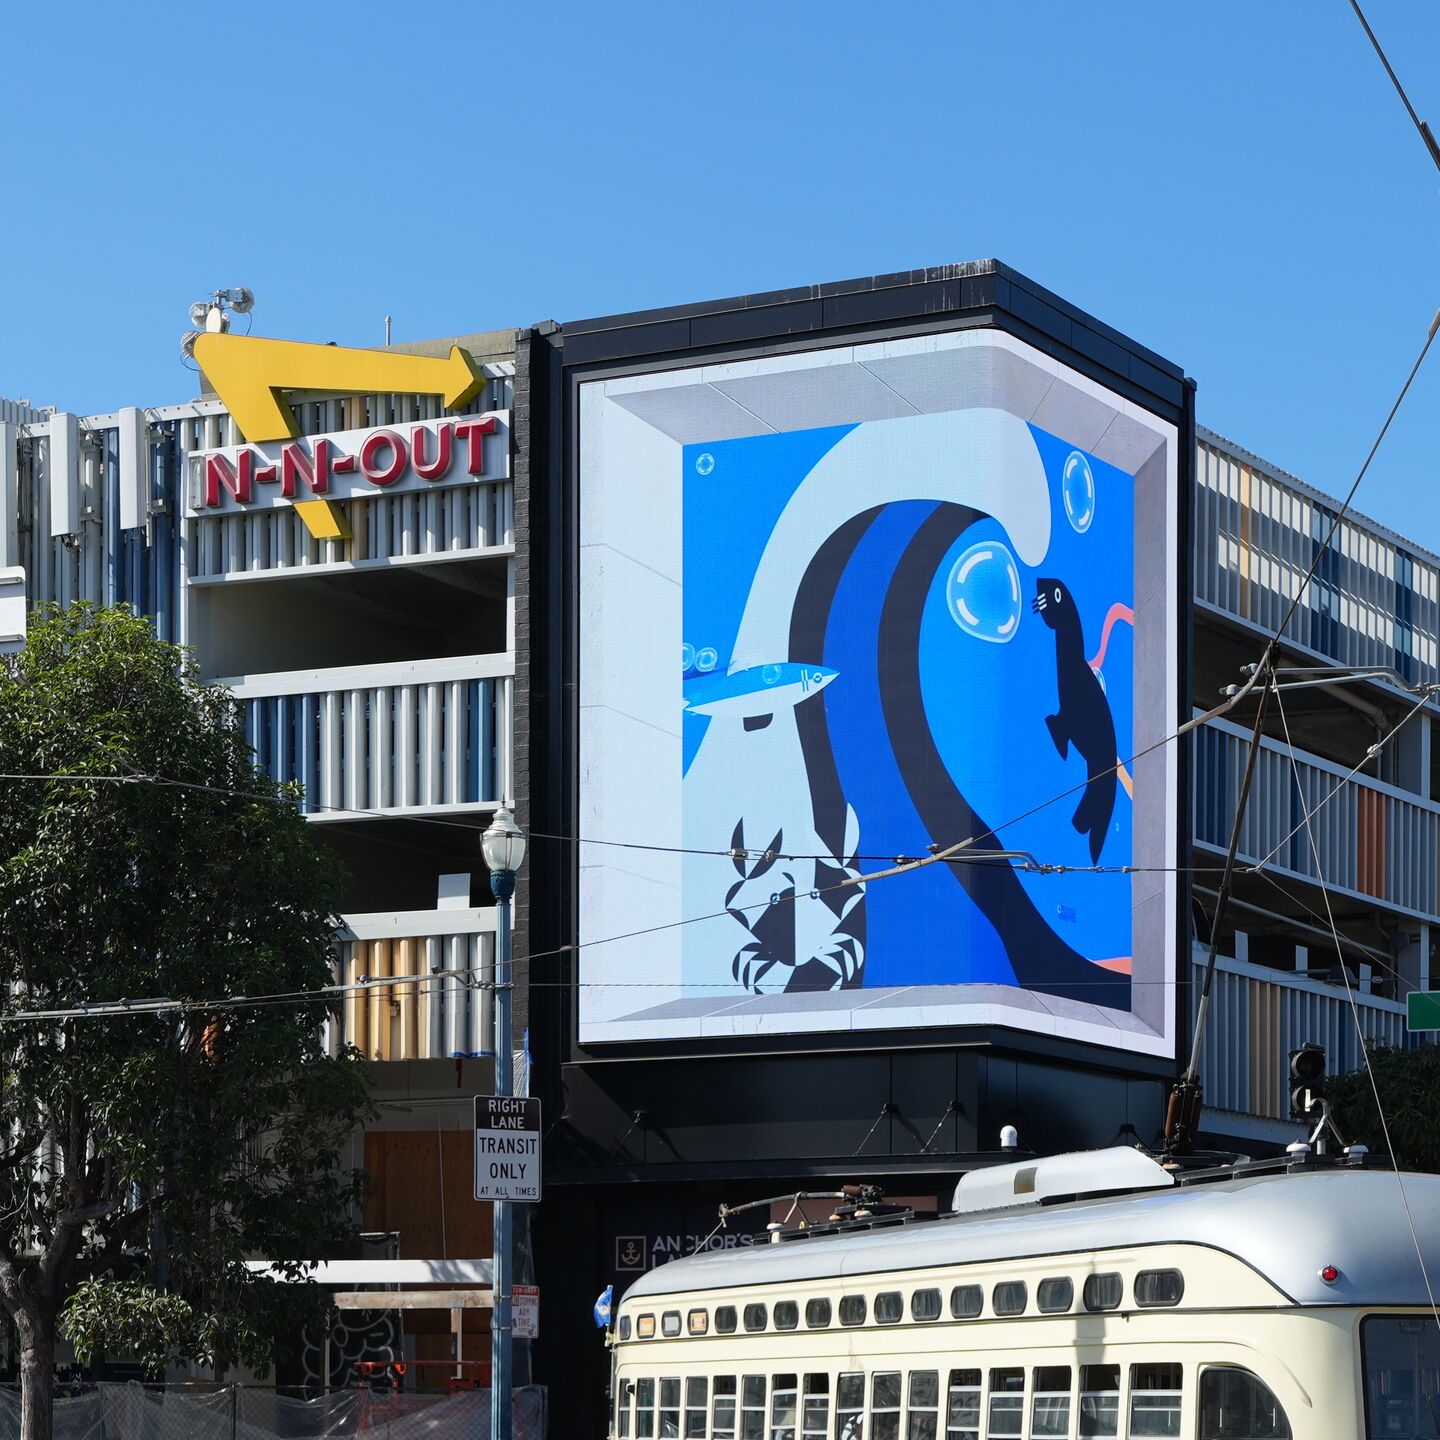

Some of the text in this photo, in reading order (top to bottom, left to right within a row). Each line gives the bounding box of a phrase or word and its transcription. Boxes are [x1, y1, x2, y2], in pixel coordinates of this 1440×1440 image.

[488, 1100, 526, 1113] RIGHT
[491, 1116, 524, 1129] LANE
[480, 1137, 536, 1155] TRANSIT
[490, 1163, 527, 1179] ONLY
[480, 1187, 537, 1196] AT ALL TIMES
